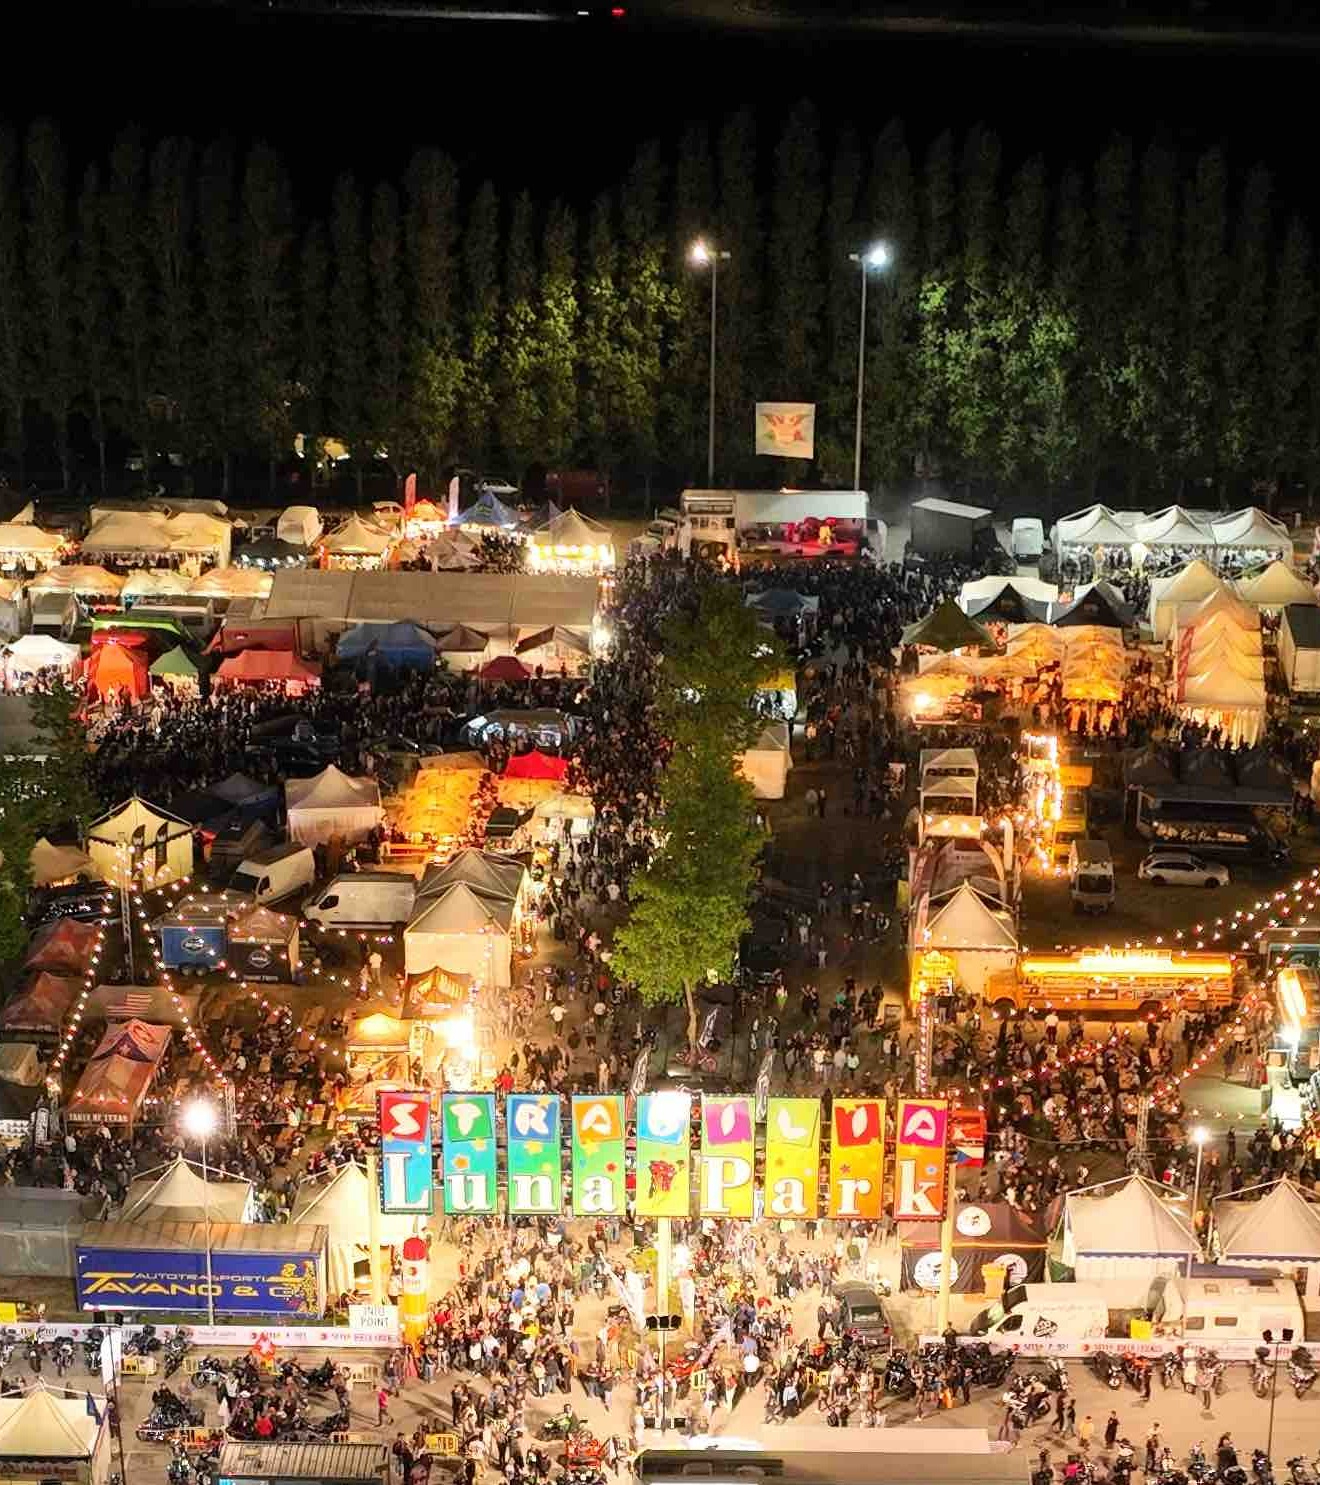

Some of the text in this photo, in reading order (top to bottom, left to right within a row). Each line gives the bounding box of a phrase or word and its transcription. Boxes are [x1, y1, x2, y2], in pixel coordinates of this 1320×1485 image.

[384, 1152, 941, 1216] Luna Park
[82, 1271, 222, 1297] TAVANO
[233, 1286, 259, 1297] &
[133, 1272, 265, 1283] AUTOTRASPORTI
